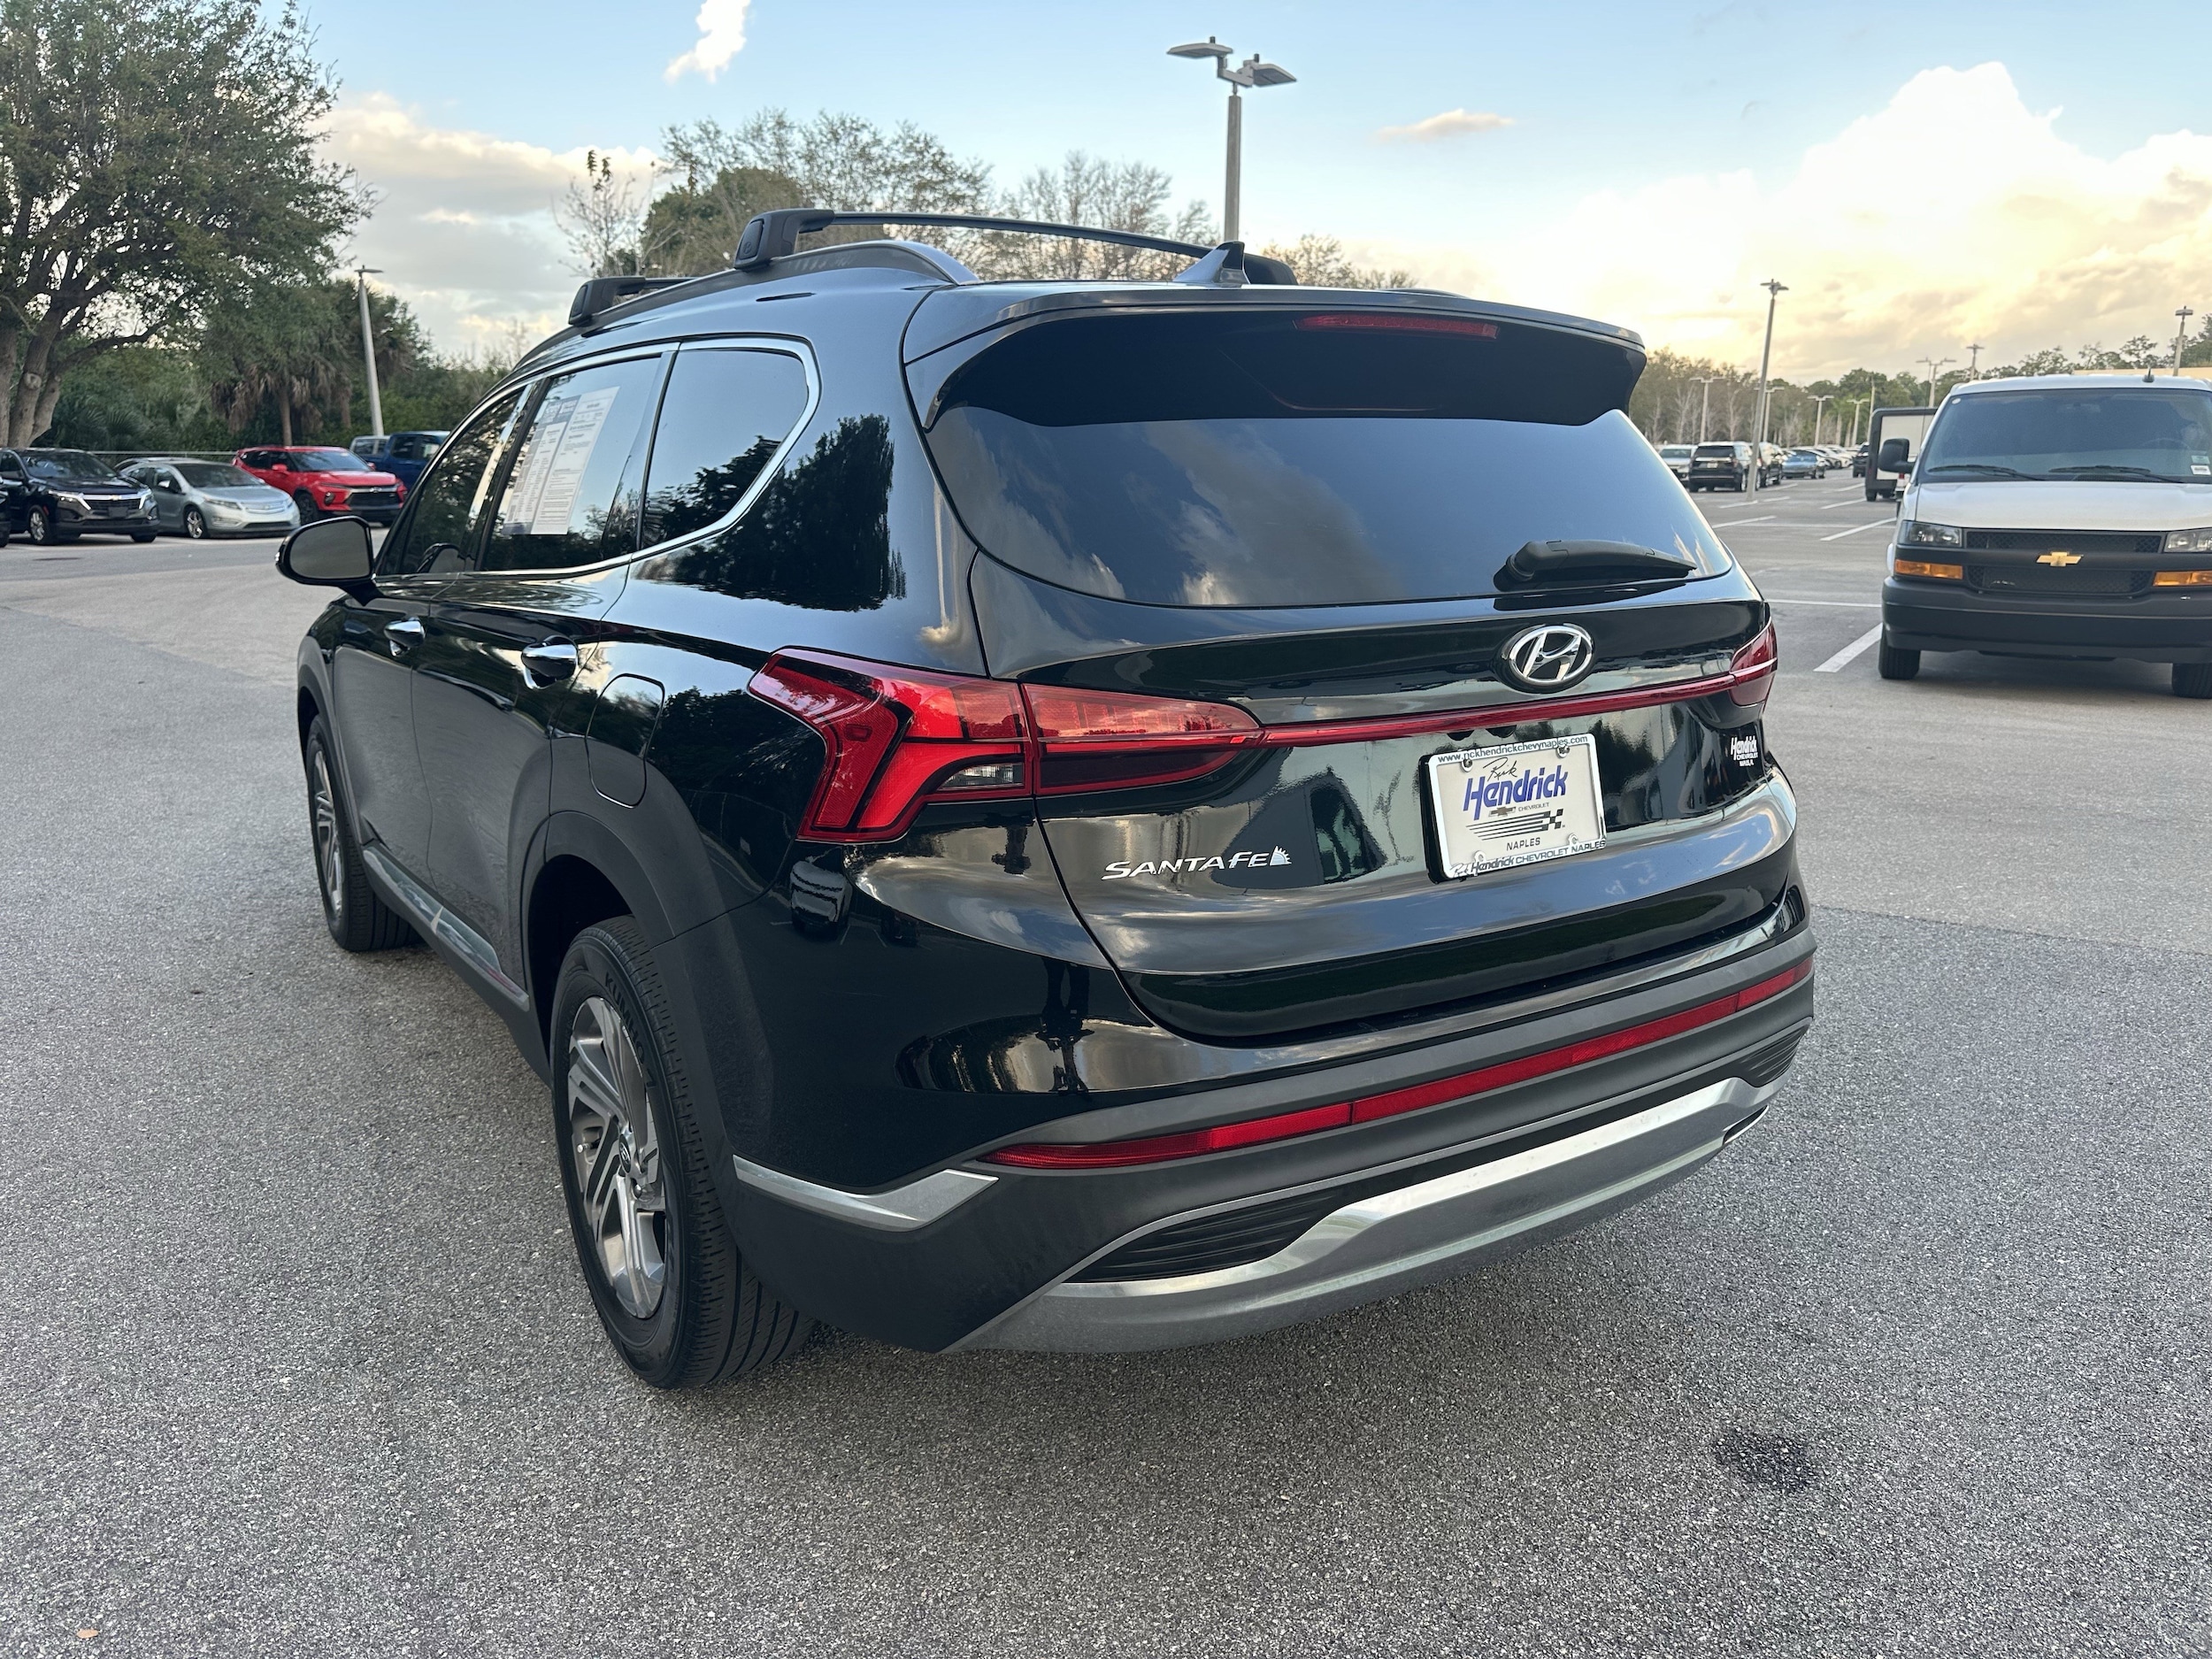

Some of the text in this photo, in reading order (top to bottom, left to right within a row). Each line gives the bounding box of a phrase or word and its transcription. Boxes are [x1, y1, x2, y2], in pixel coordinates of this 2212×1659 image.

[1438, 735, 1588, 763] www.rickhendrickchevynaples.com
[1463, 764, 1568, 820] Hendrick
[1518, 803, 1549, 812] CHEVROLET
[1471, 856, 1514, 874] Hendrick
[1516, 847, 1569, 864] CHEVROLET
[1571, 839, 1606, 854] NAPLES
[1507, 837, 1540, 851] NAPLES
[1102, 851, 1270, 880] SANTA FE
